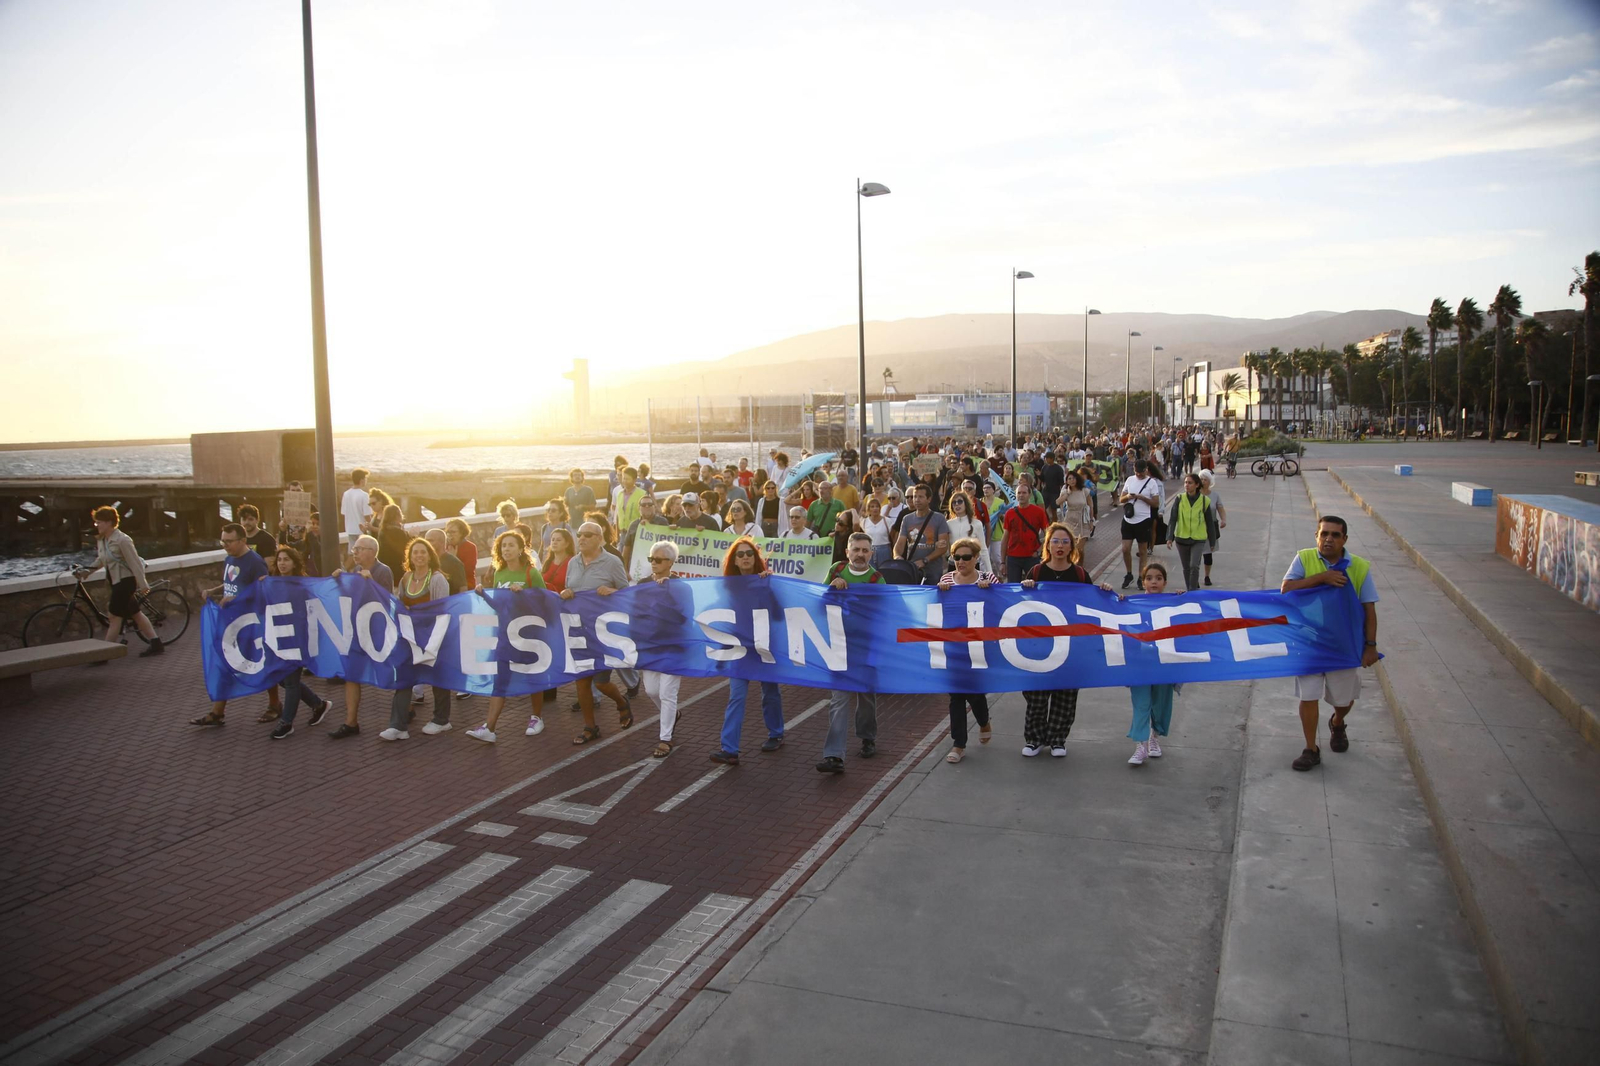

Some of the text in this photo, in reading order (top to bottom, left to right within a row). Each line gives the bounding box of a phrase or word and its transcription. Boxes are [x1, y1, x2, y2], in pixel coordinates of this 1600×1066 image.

[640, 528, 654, 542] Los
[655, 532, 699, 547] vecinos
[702, 538, 709, 550] y
[766, 541, 785, 553] del
[788, 543, 832, 558] parque
[222, 596, 1289, 675] GENOVESES SIN HOTEL
